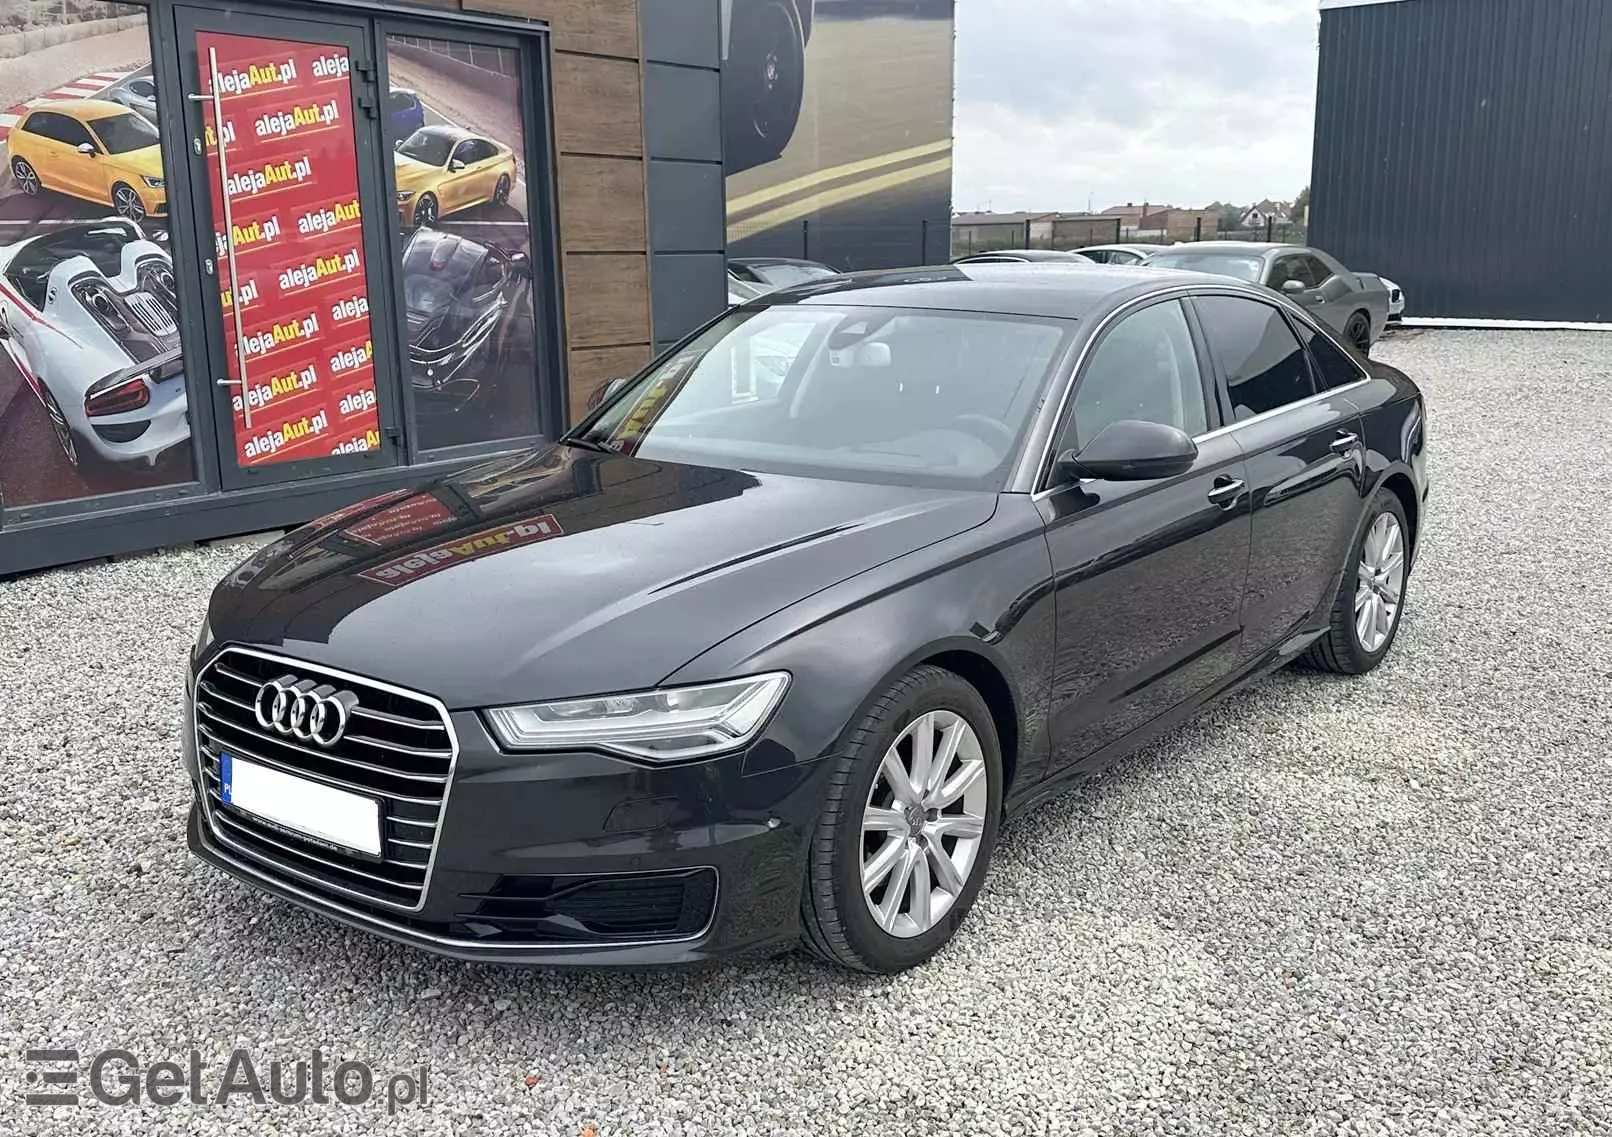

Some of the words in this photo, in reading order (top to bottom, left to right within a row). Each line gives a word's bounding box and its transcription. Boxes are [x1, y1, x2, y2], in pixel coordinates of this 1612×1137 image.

[312, 54, 350, 77] aleja
[255, 100, 340, 136] alejaAut.pl
[226, 156, 312, 195] alejaAut.pl
[298, 199, 361, 234] alejaAut
[279, 248, 360, 289] alejaAut.pl
[331, 296, 369, 320] aleja
[232, 364, 318, 411] aejaAut.pl
[244, 409, 329, 458] alejaAut.pl
